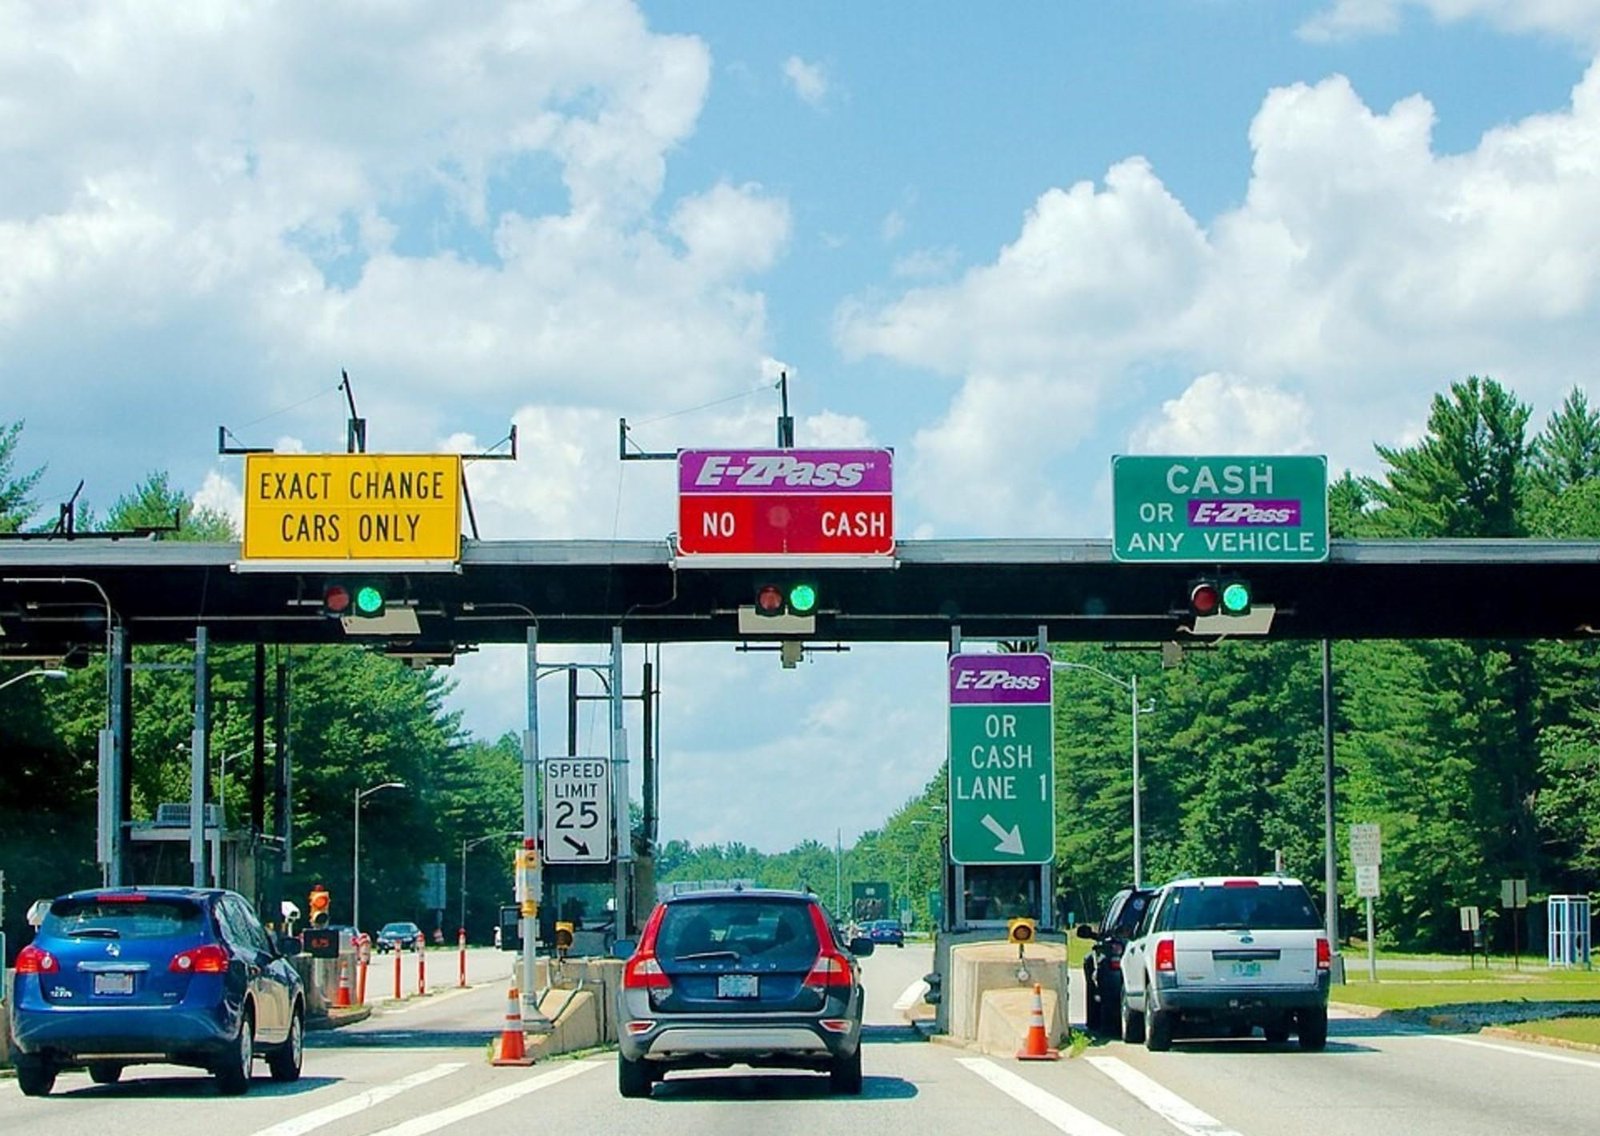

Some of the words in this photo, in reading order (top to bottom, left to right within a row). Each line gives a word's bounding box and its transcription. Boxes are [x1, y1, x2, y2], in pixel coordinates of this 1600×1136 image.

[260, 472, 331, 500] EXACT
[350, 471, 444, 500] CHANGE
[1166, 464, 1273, 494] CASH
[702, 511, 736, 537] NO
[821, 511, 885, 537] CASH
[1139, 502, 1174, 523] OR
[281, 513, 340, 542] CARS
[358, 513, 420, 542] ONLY
[1127, 532, 1184, 553] ANY
[1203, 532, 1315, 552] VEHICLE
[985, 714, 1017, 738] OR
[971, 744, 1032, 769] CASH
[549, 763, 604, 778] SPEED
[554, 783, 597, 798] LIMIT
[957, 776, 1017, 800] LANE
[1039, 773, 1046, 802] 1
[555, 801, 599, 829] 25
